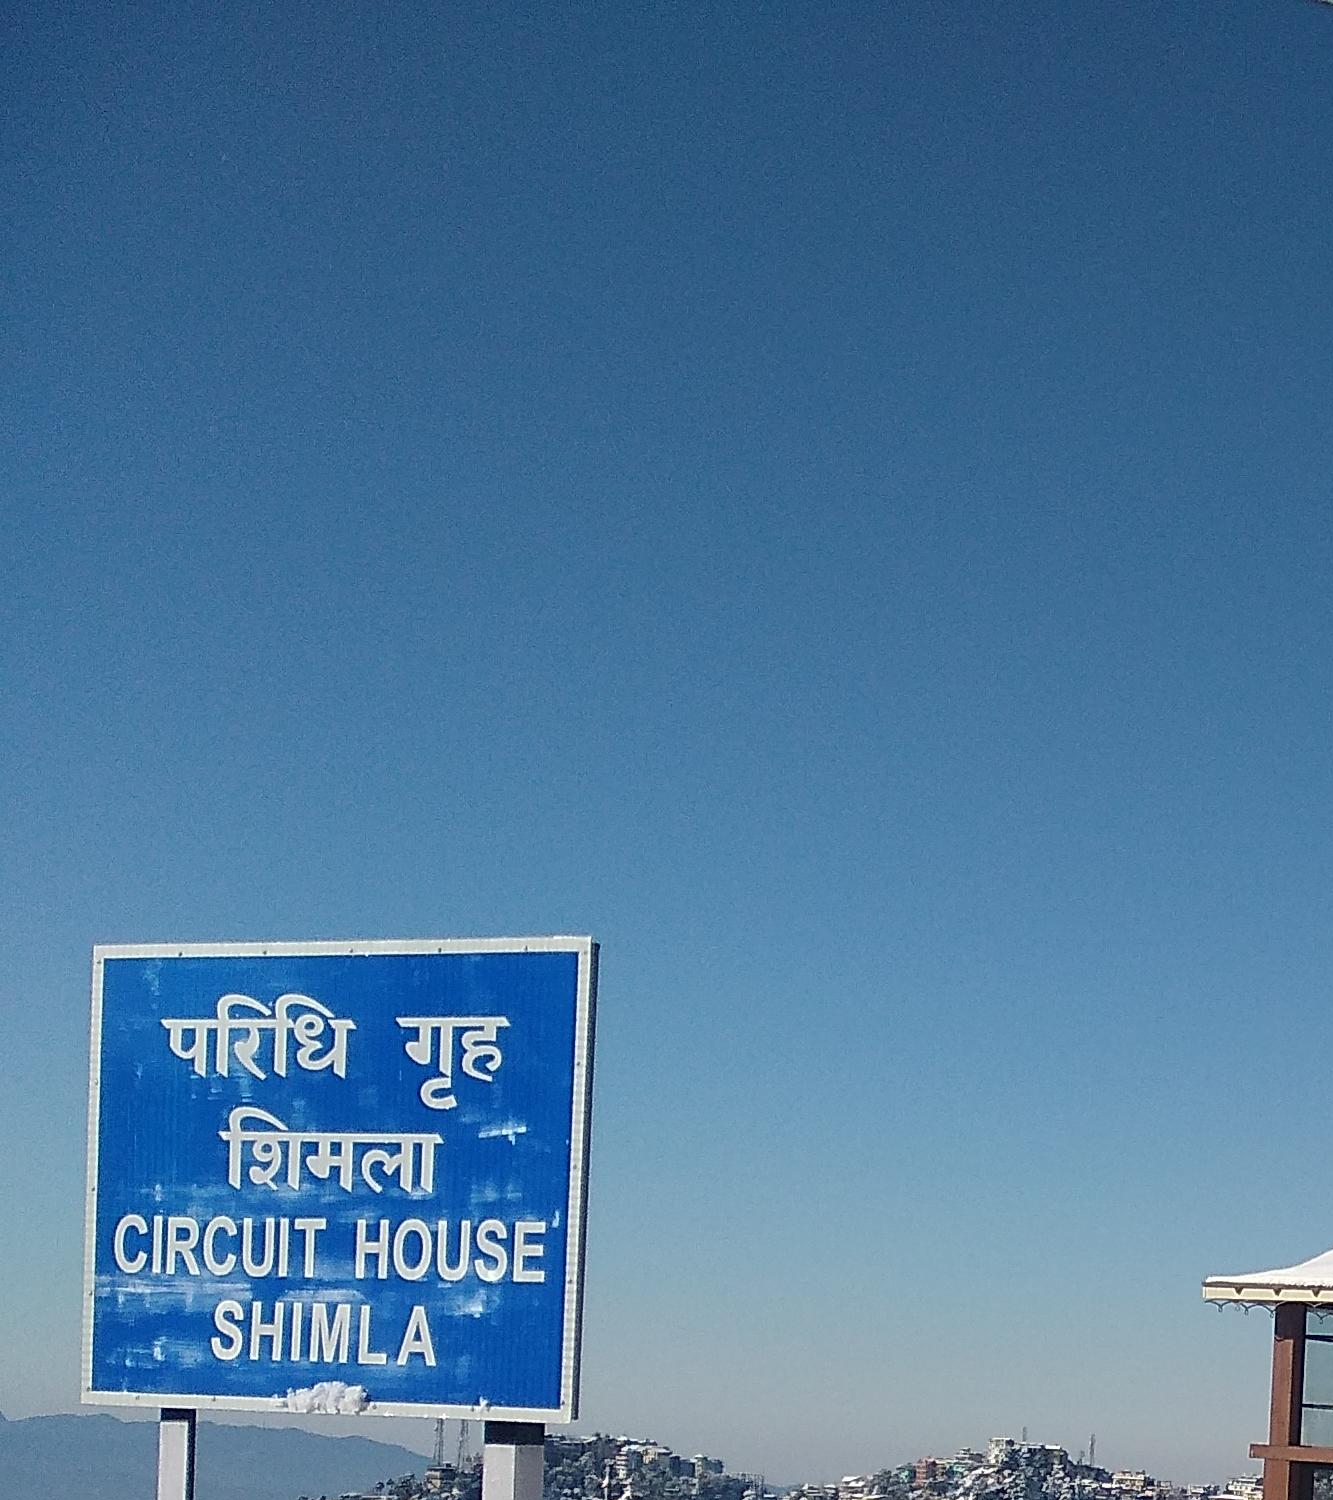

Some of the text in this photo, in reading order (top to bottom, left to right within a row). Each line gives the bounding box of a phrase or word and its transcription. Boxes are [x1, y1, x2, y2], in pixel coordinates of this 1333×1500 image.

[161, 992, 511, 1110] परिधि गृह
[217, 1105, 445, 1195] शिमला
[112, 1213, 547, 1284] CIRCUIT HOUSE
[210, 1299, 438, 1368] SHIMLA
